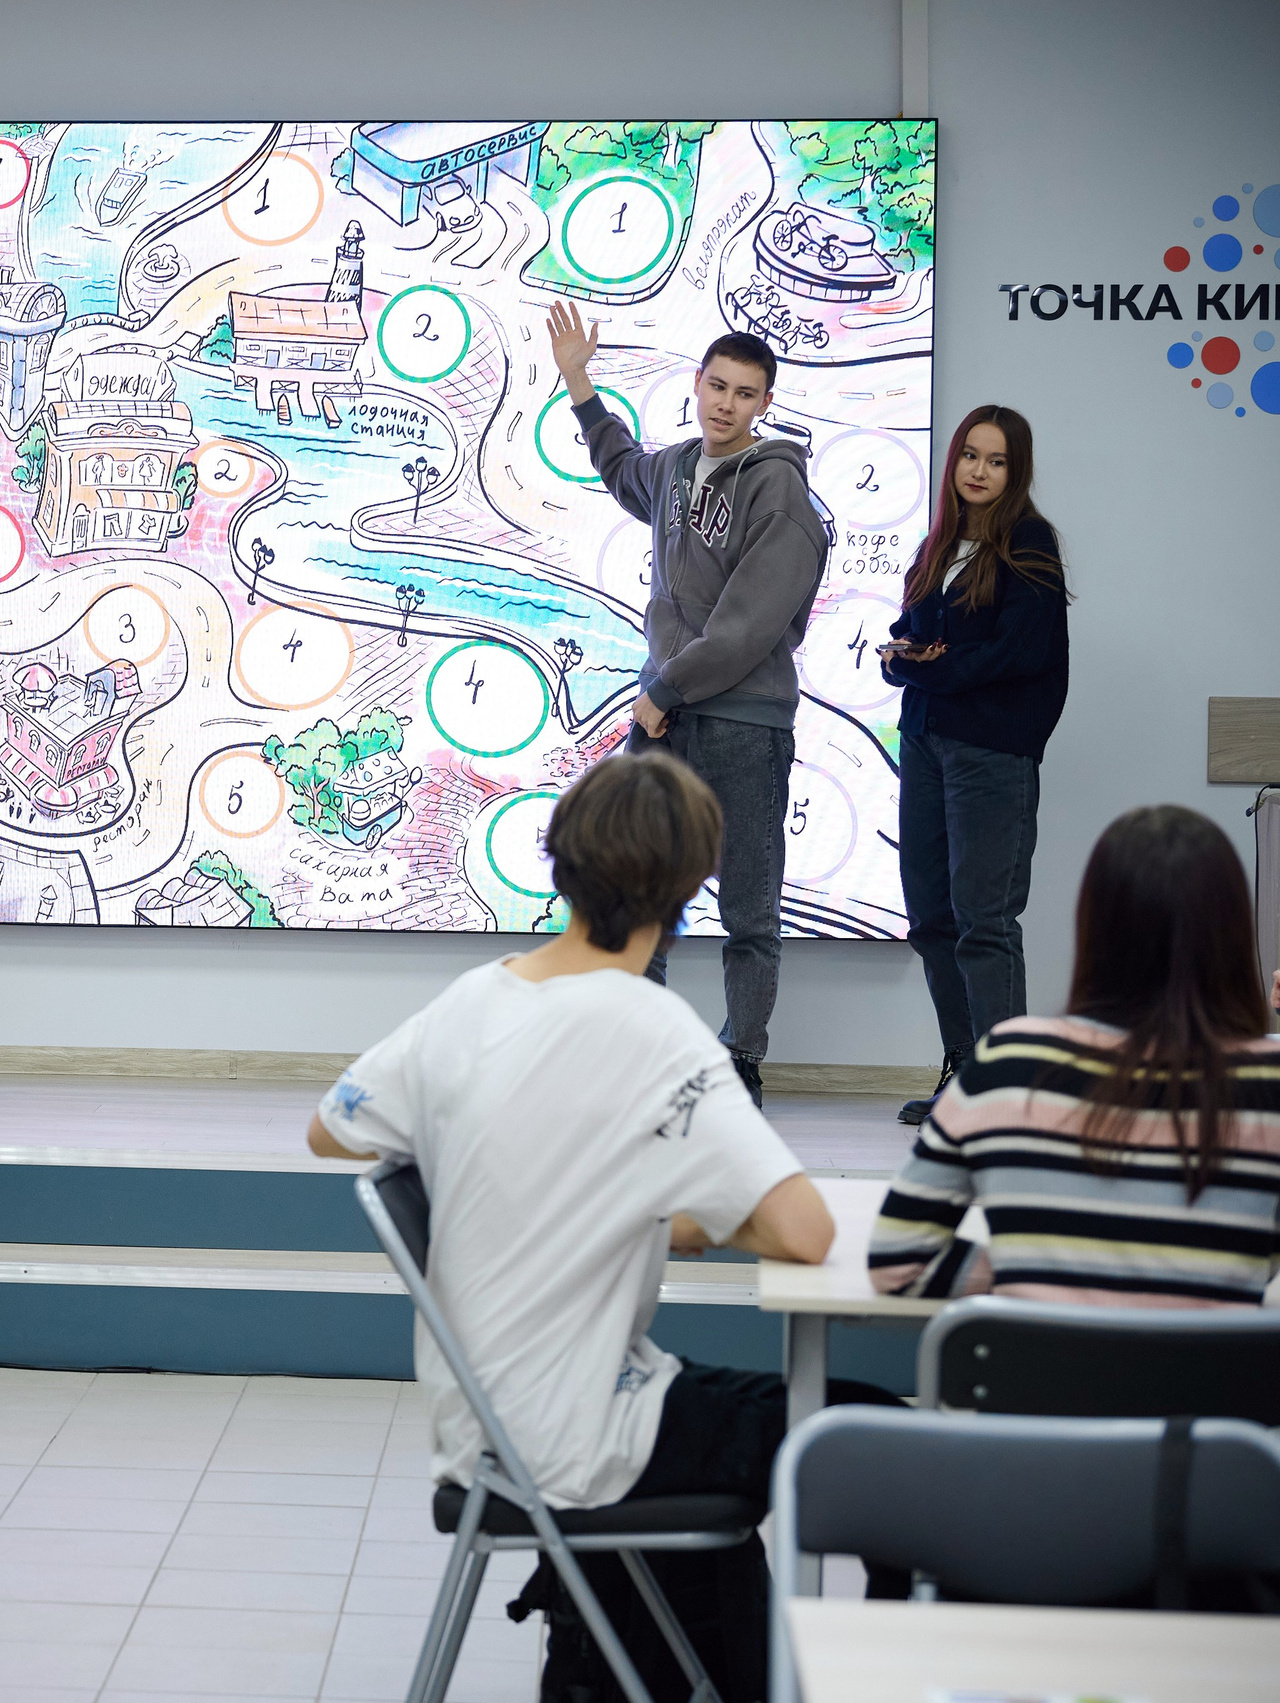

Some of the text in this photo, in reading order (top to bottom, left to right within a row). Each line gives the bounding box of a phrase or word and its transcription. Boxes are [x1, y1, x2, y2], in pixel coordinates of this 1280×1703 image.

[253, 178, 270, 215] 1
[610, 202, 628, 234] 1
[998, 284, 1280, 321] ТОЧКА КИ
[412, 313, 440, 342] 2
[348, 404, 429, 427] лодочная
[676, 397, 693, 427] 1
[351, 422, 426, 441] станция
[214, 459, 239, 482] 2
[855, 463, 880, 492] 2
[846, 530, 899, 554] кофе
[842, 553, 902, 575] собой
[118, 612, 136, 644] 3
[847, 619, 869, 669] 4
[282, 630, 303, 663] 4
[464, 659, 485, 705] 4
[227, 780, 244, 815] 5
[93, 778, 153, 853] ресторан
[790, 797, 809, 836] 5
[289, 846, 390, 883] сахарная
